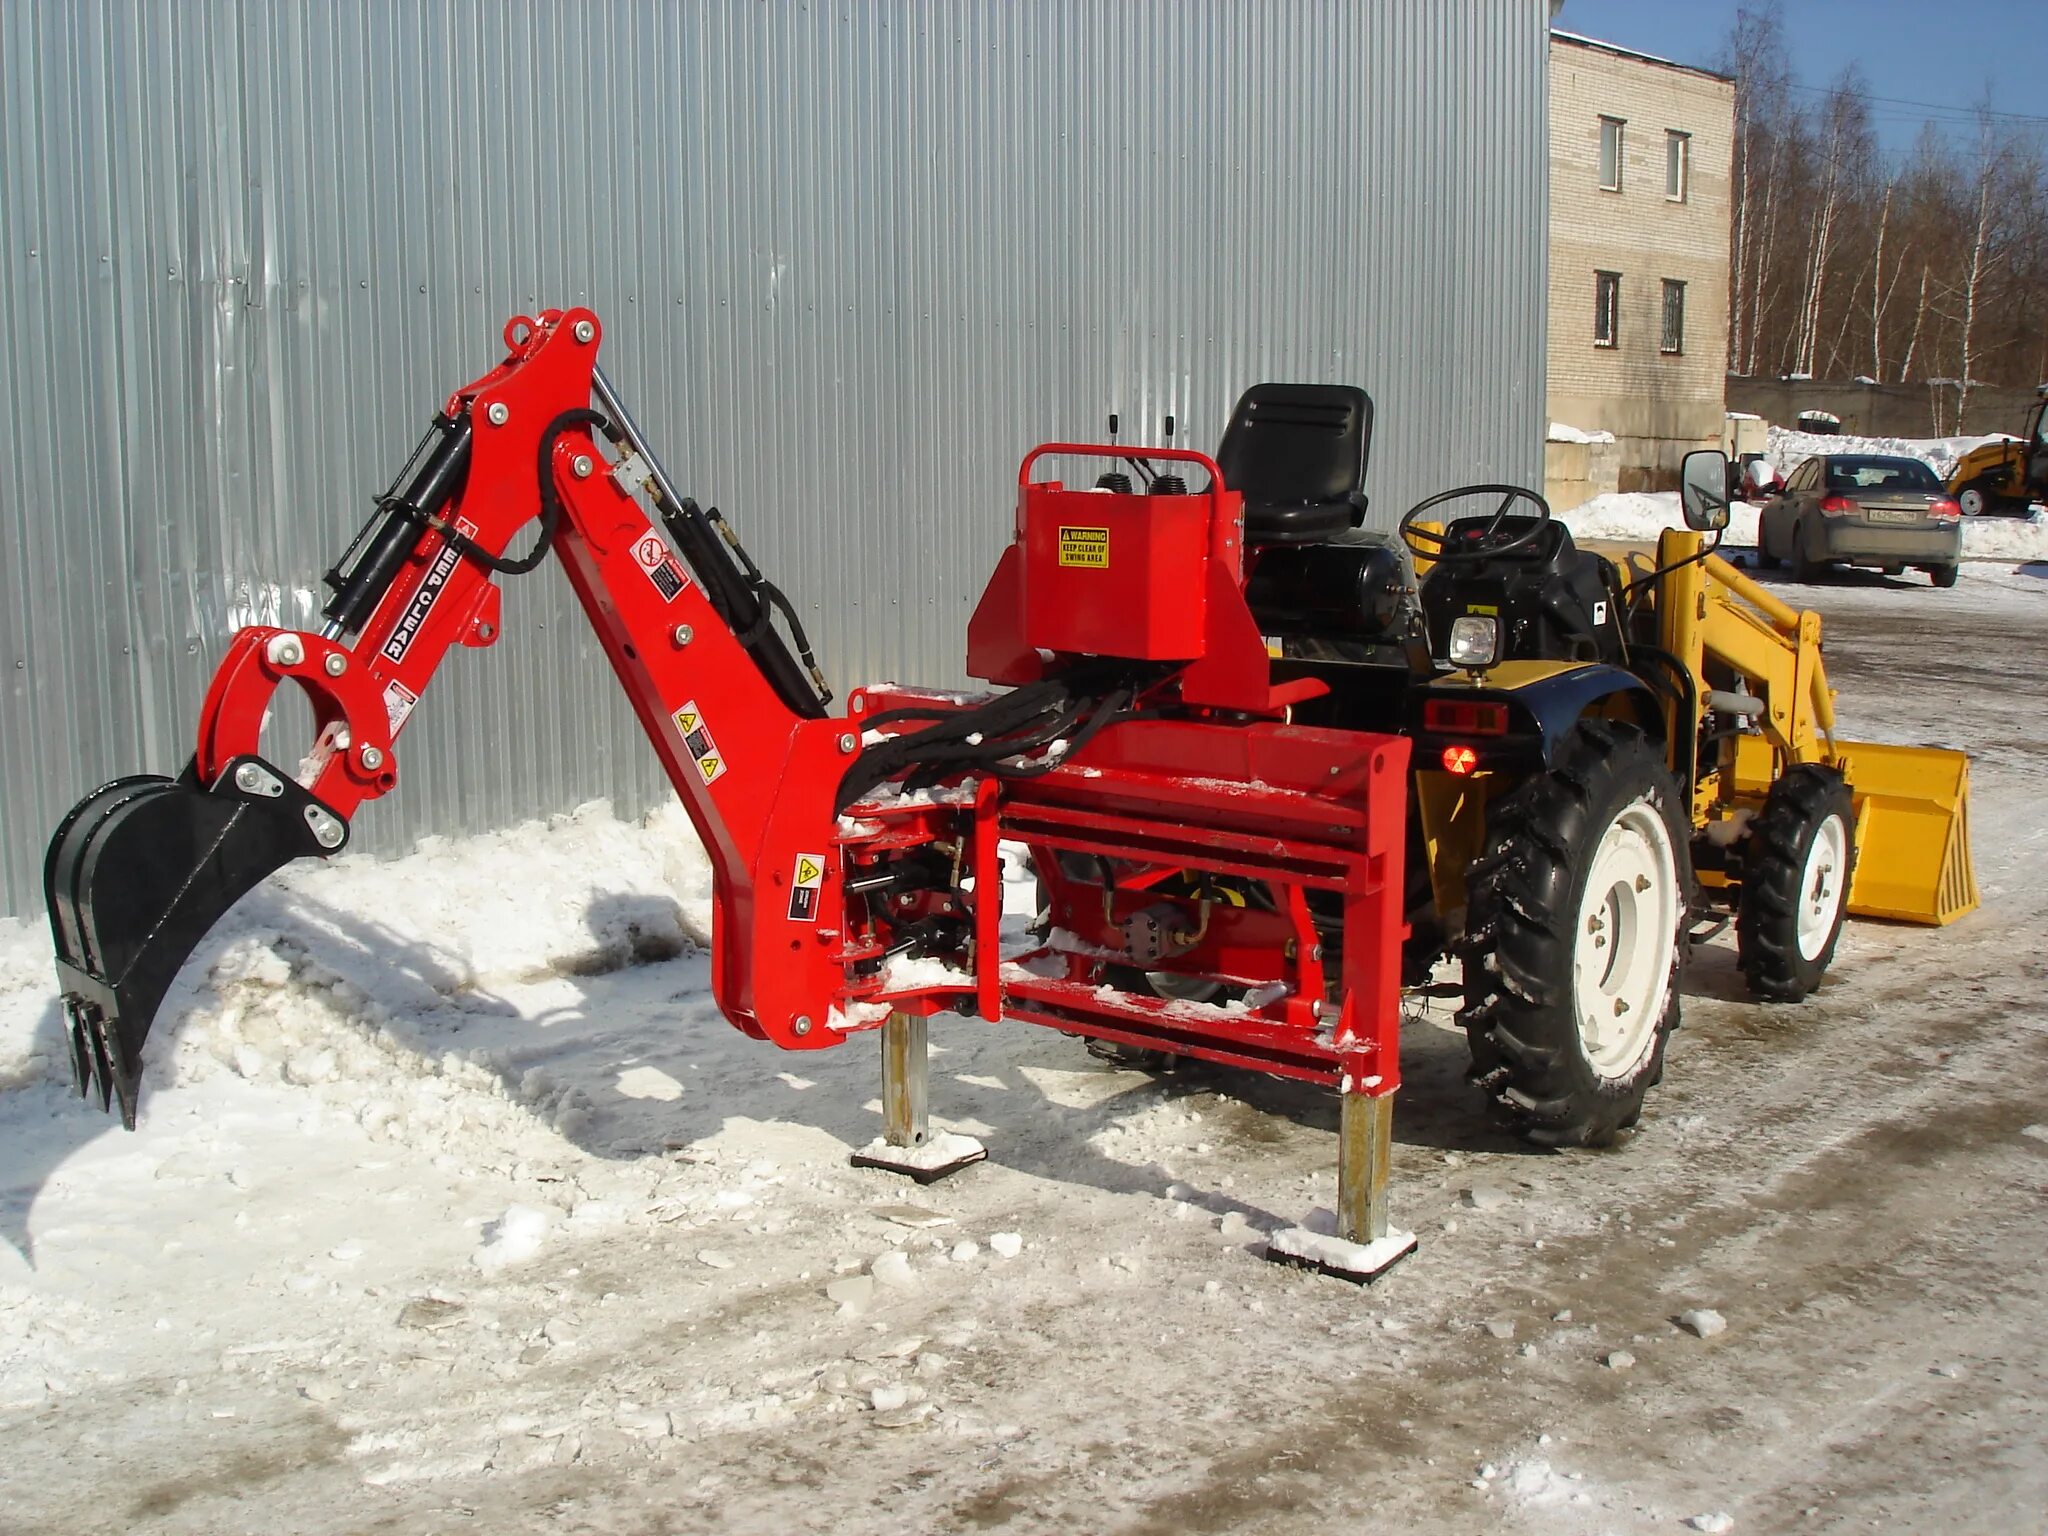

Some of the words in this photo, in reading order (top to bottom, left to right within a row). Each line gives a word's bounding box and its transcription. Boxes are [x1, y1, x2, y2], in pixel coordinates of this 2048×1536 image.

[1071, 531, 1106, 541] WARNING
[1063, 543, 1077, 552] KEEP
[1078, 544, 1096, 553] CLEAR
[1098, 545, 1105, 553] OF
[1066, 553, 1085, 561] SWING
[1087, 554, 1102, 562] AREA
[387, 591, 433, 658] CLEAR
